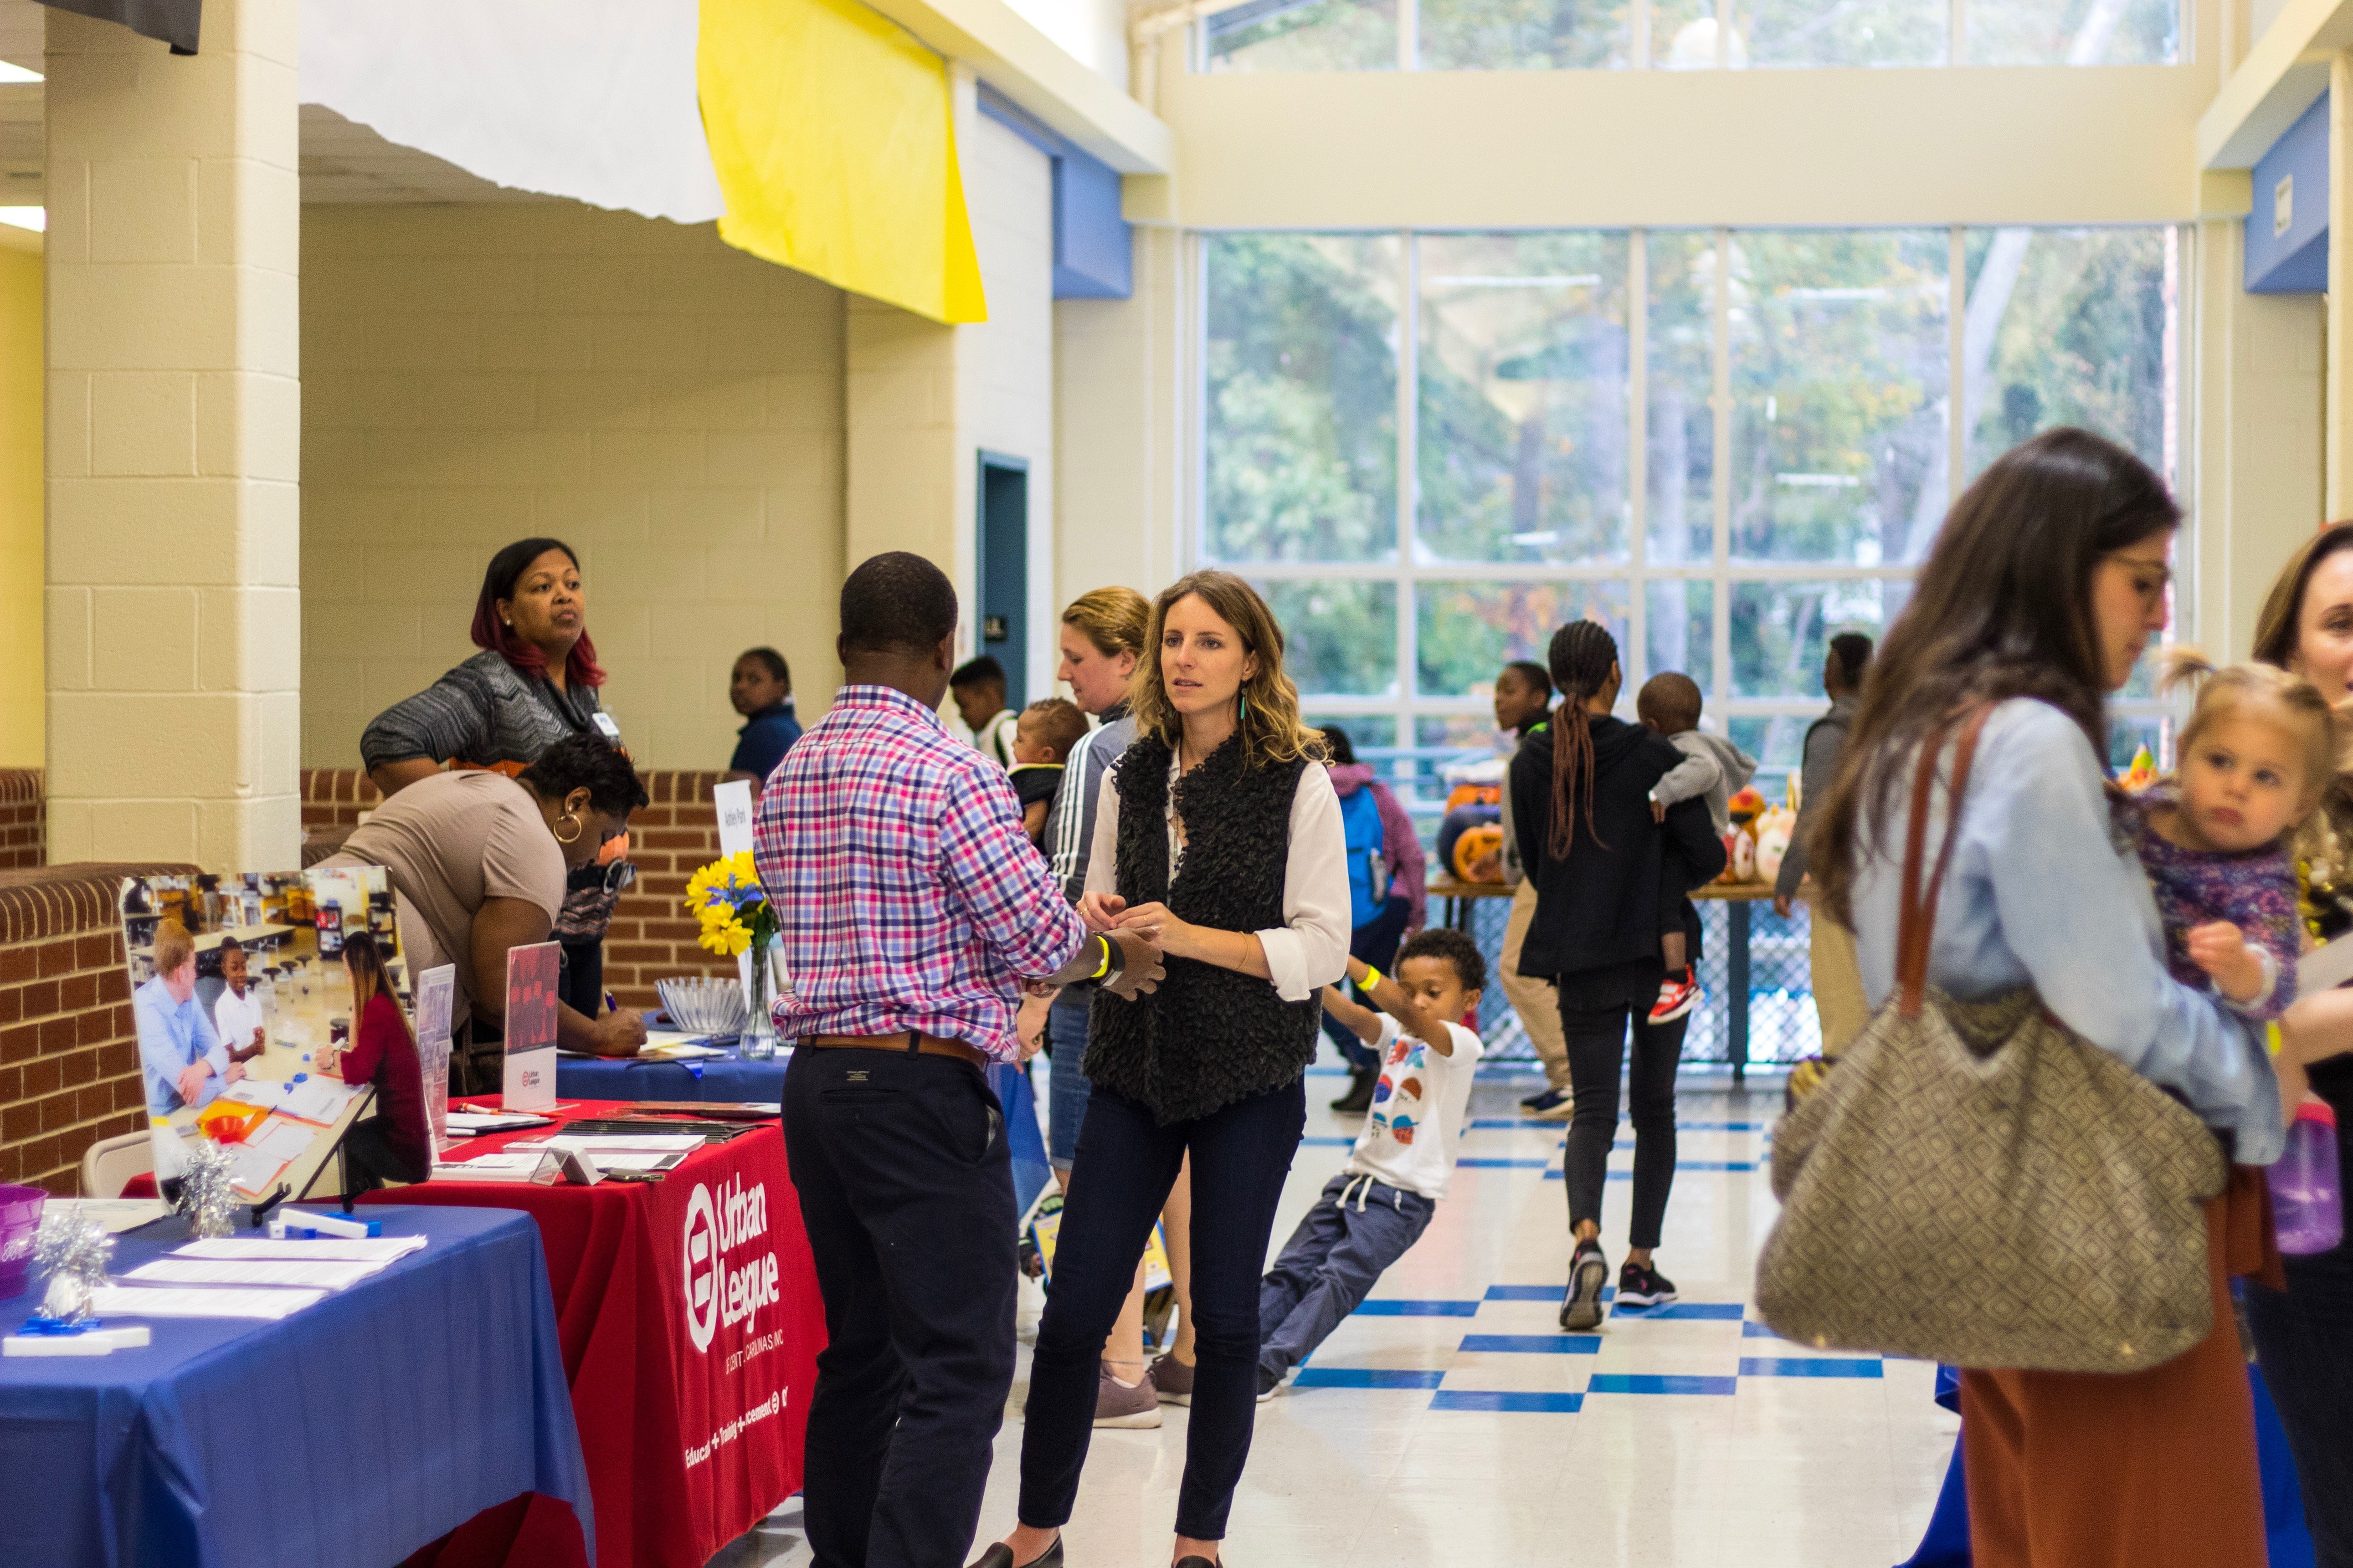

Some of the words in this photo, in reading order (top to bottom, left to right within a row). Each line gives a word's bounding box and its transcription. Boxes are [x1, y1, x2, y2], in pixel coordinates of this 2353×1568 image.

[737, 806, 746, 825] Park
[717, 1172, 767, 1252] Urban
[719, 1251, 780, 1334] League
